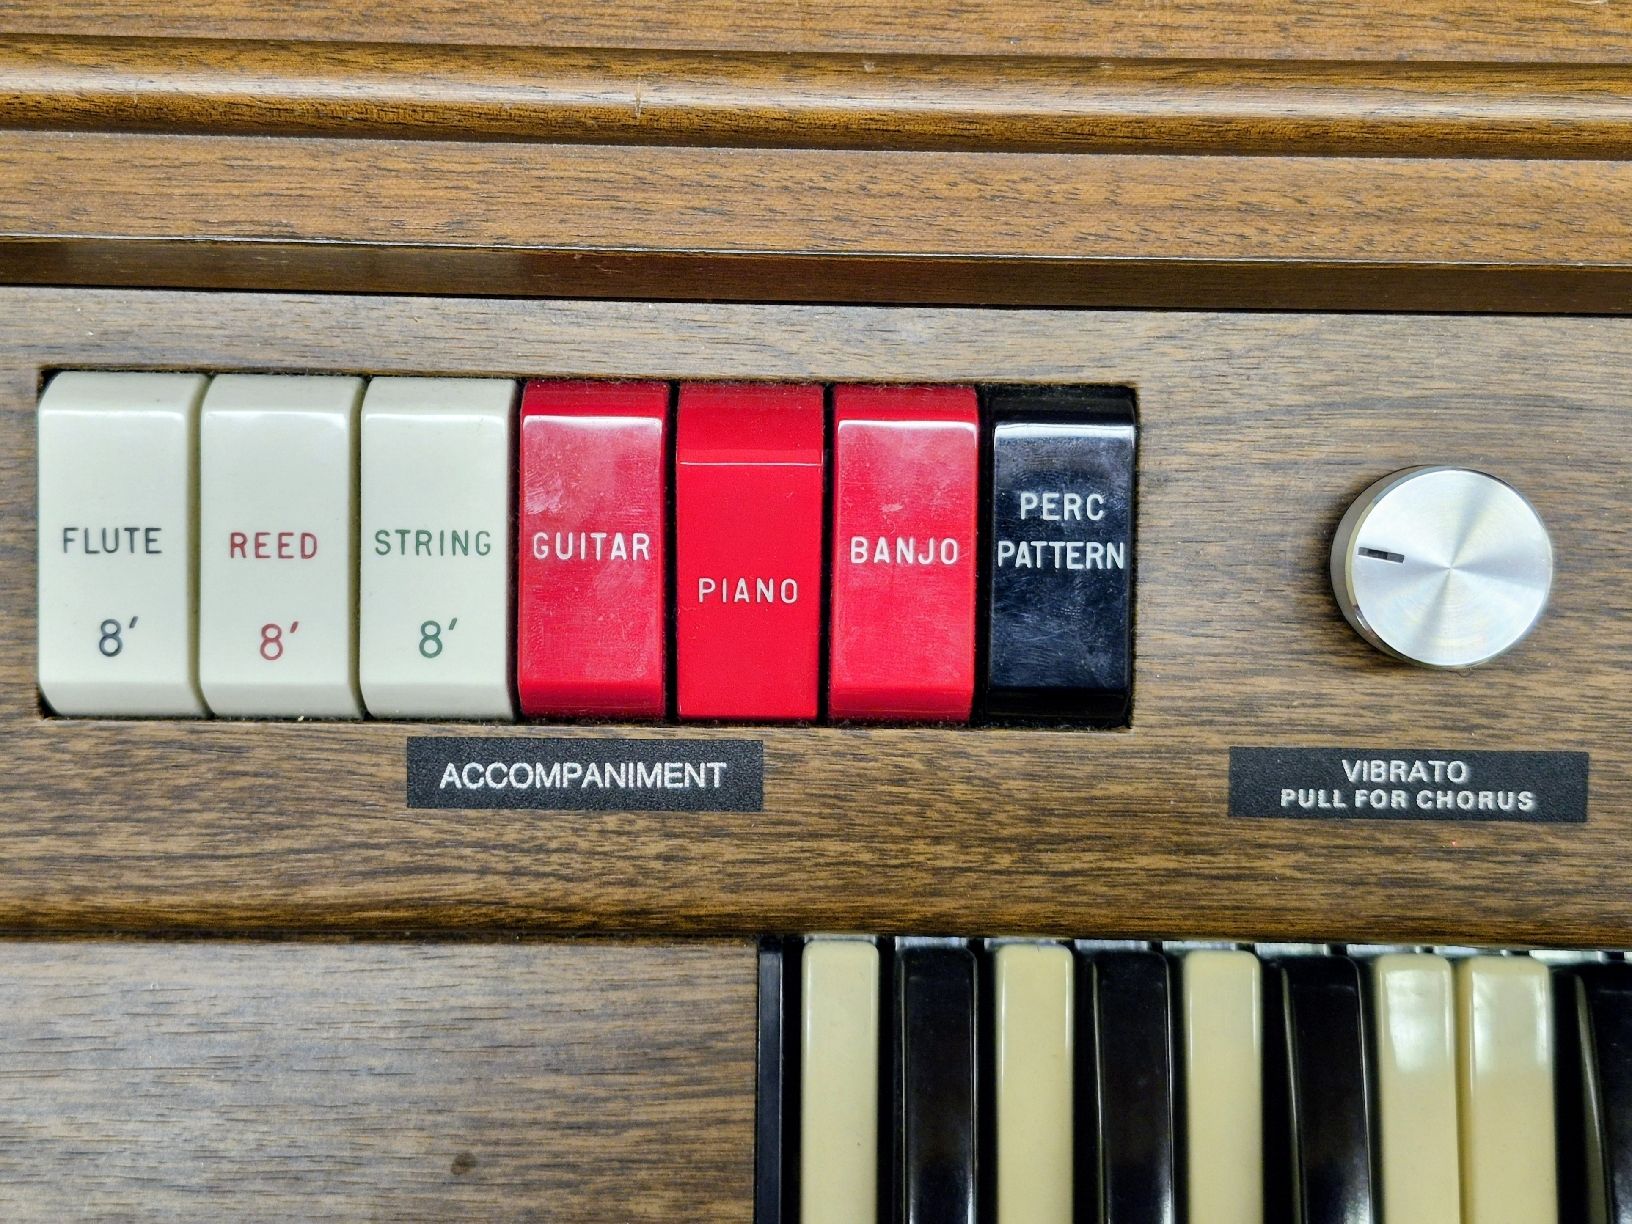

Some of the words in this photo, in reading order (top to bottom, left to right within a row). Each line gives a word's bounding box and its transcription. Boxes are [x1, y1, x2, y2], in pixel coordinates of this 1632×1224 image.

[1020, 491, 1105, 521] PERC
[62, 526, 163, 555] FLUTE
[229, 531, 318, 560] REED
[374, 528, 491, 557] STRING
[532, 531, 650, 561] GUITAR
[850, 535, 959, 565] BANJO
[997, 540, 1126, 570] PATTERN
[698, 577, 798, 604] PIANO
[439, 761, 728, 790] ACCOMPANIMENT
[1341, 759, 1469, 784] VIBRATO
[1280, 788, 1347, 809] PULL
[1354, 788, 1408, 810] FOR
[1416, 789, 1536, 812] CHORUS
